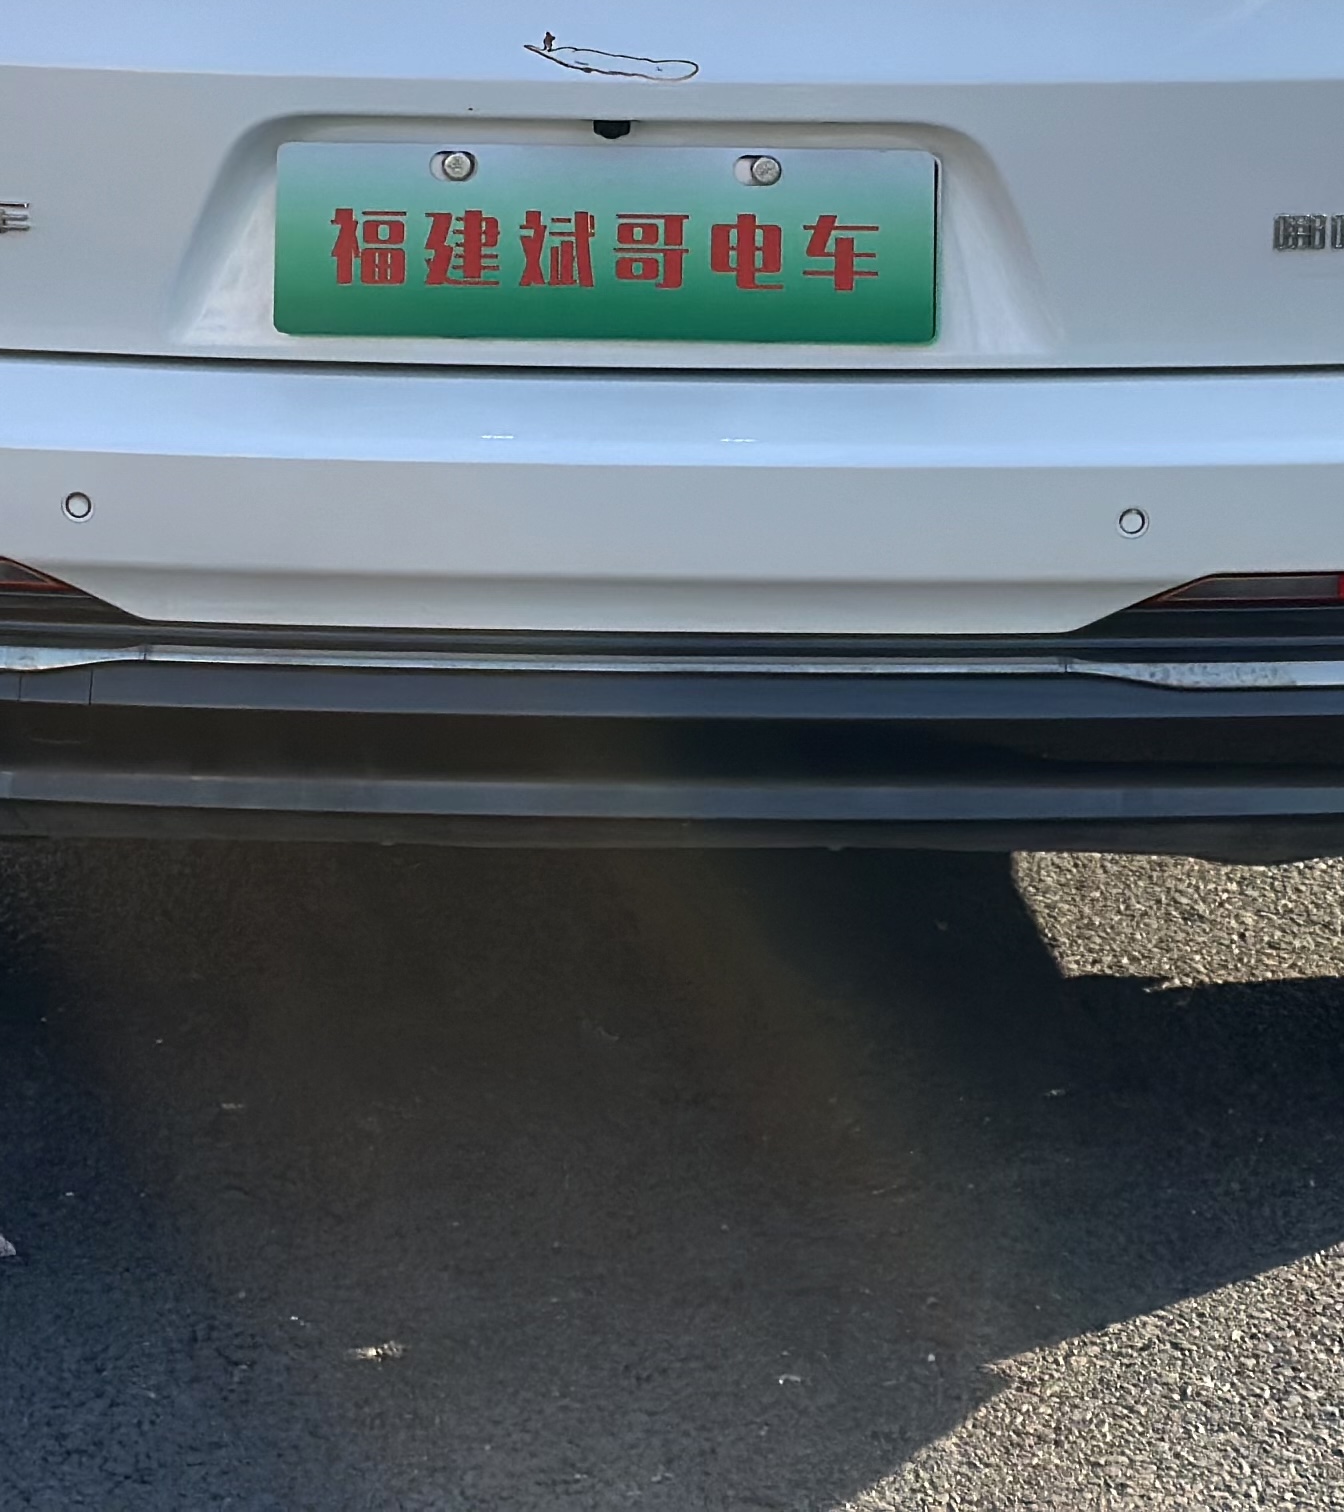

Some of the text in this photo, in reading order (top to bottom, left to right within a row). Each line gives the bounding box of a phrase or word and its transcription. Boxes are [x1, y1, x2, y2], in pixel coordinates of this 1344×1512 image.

[330, 207, 880, 292] 福建斌哥电车
